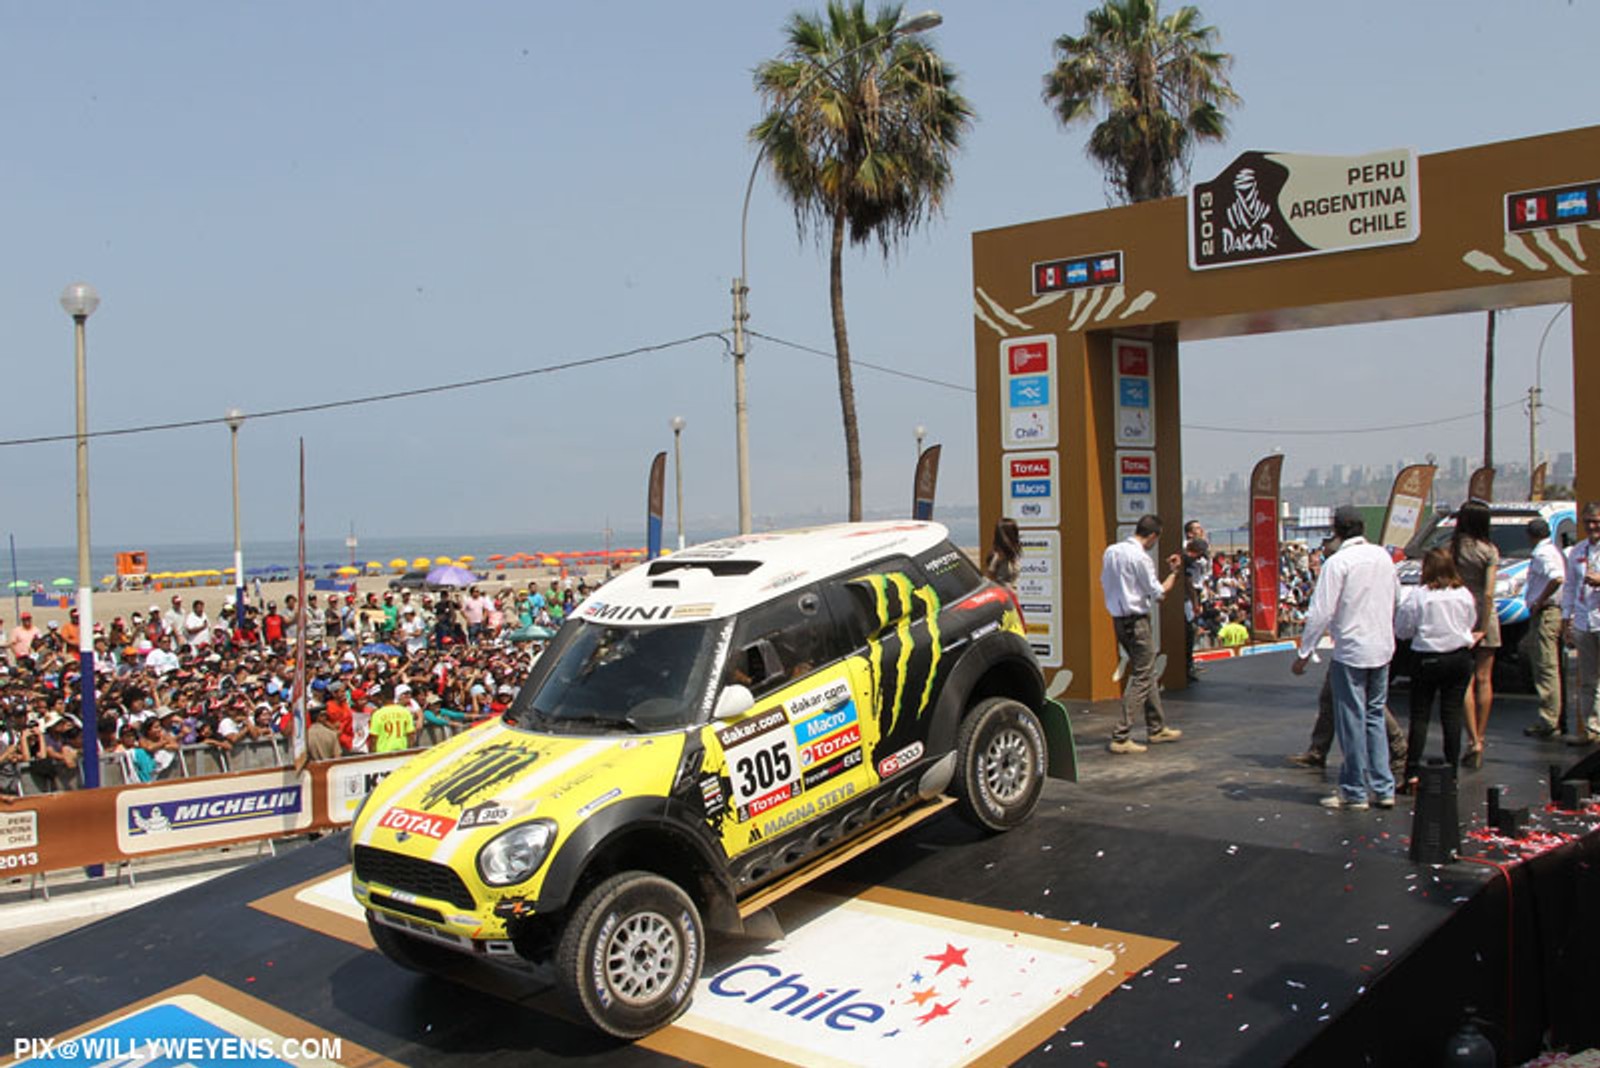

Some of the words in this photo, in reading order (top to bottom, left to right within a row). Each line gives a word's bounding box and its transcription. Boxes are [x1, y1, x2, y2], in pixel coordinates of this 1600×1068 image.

[1347, 160, 1406, 186] PERU
[1289, 186, 1407, 220] ARGENTINA
[1200, 192, 1215, 257] 2013
[1348, 211, 1407, 236] CHILE
[1221, 223, 1278, 255] DAKAR
[1014, 427, 1039, 439] Chile
[1013, 462, 1047, 473] TOTAL
[1015, 483, 1046, 495] Macro
[594, 604, 673, 619] MINI
[789, 684, 848, 714] dakar.com
[721, 712, 785, 745] dakar.com
[807, 711, 846, 737] Macro
[815, 732, 860, 757] TOTAL
[736, 741, 792, 798] 305
[174, 791, 297, 822] MICHELIN
[481, 808, 507, 820] 305
[751, 792, 788, 813] TOTAL
[763, 802, 815, 837] MAGNA
[816, 782, 855, 810] STEYR
[384, 809, 442, 838] TOTAL
[0, 852, 38, 869] 2013
[708, 963, 887, 1032] Chile
